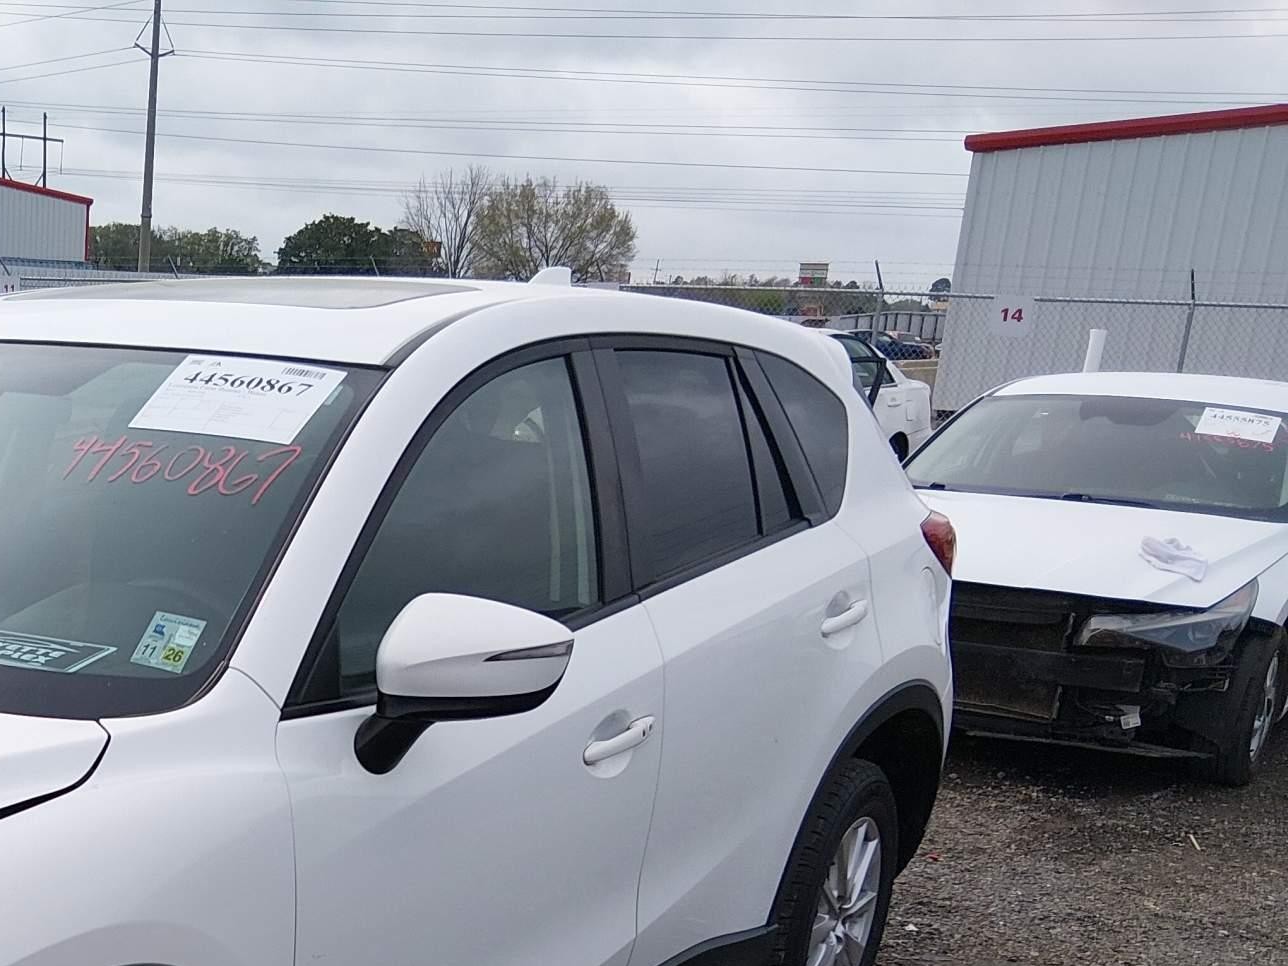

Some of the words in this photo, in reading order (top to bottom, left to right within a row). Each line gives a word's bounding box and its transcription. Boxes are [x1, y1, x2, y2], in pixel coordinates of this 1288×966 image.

[1001, 308, 1023, 322] 14
[184, 370, 314, 397] 44560867
[62, 434, 302, 505] 44560867
[141, 643, 157, 658] 11
[162, 648, 185, 663] 26
